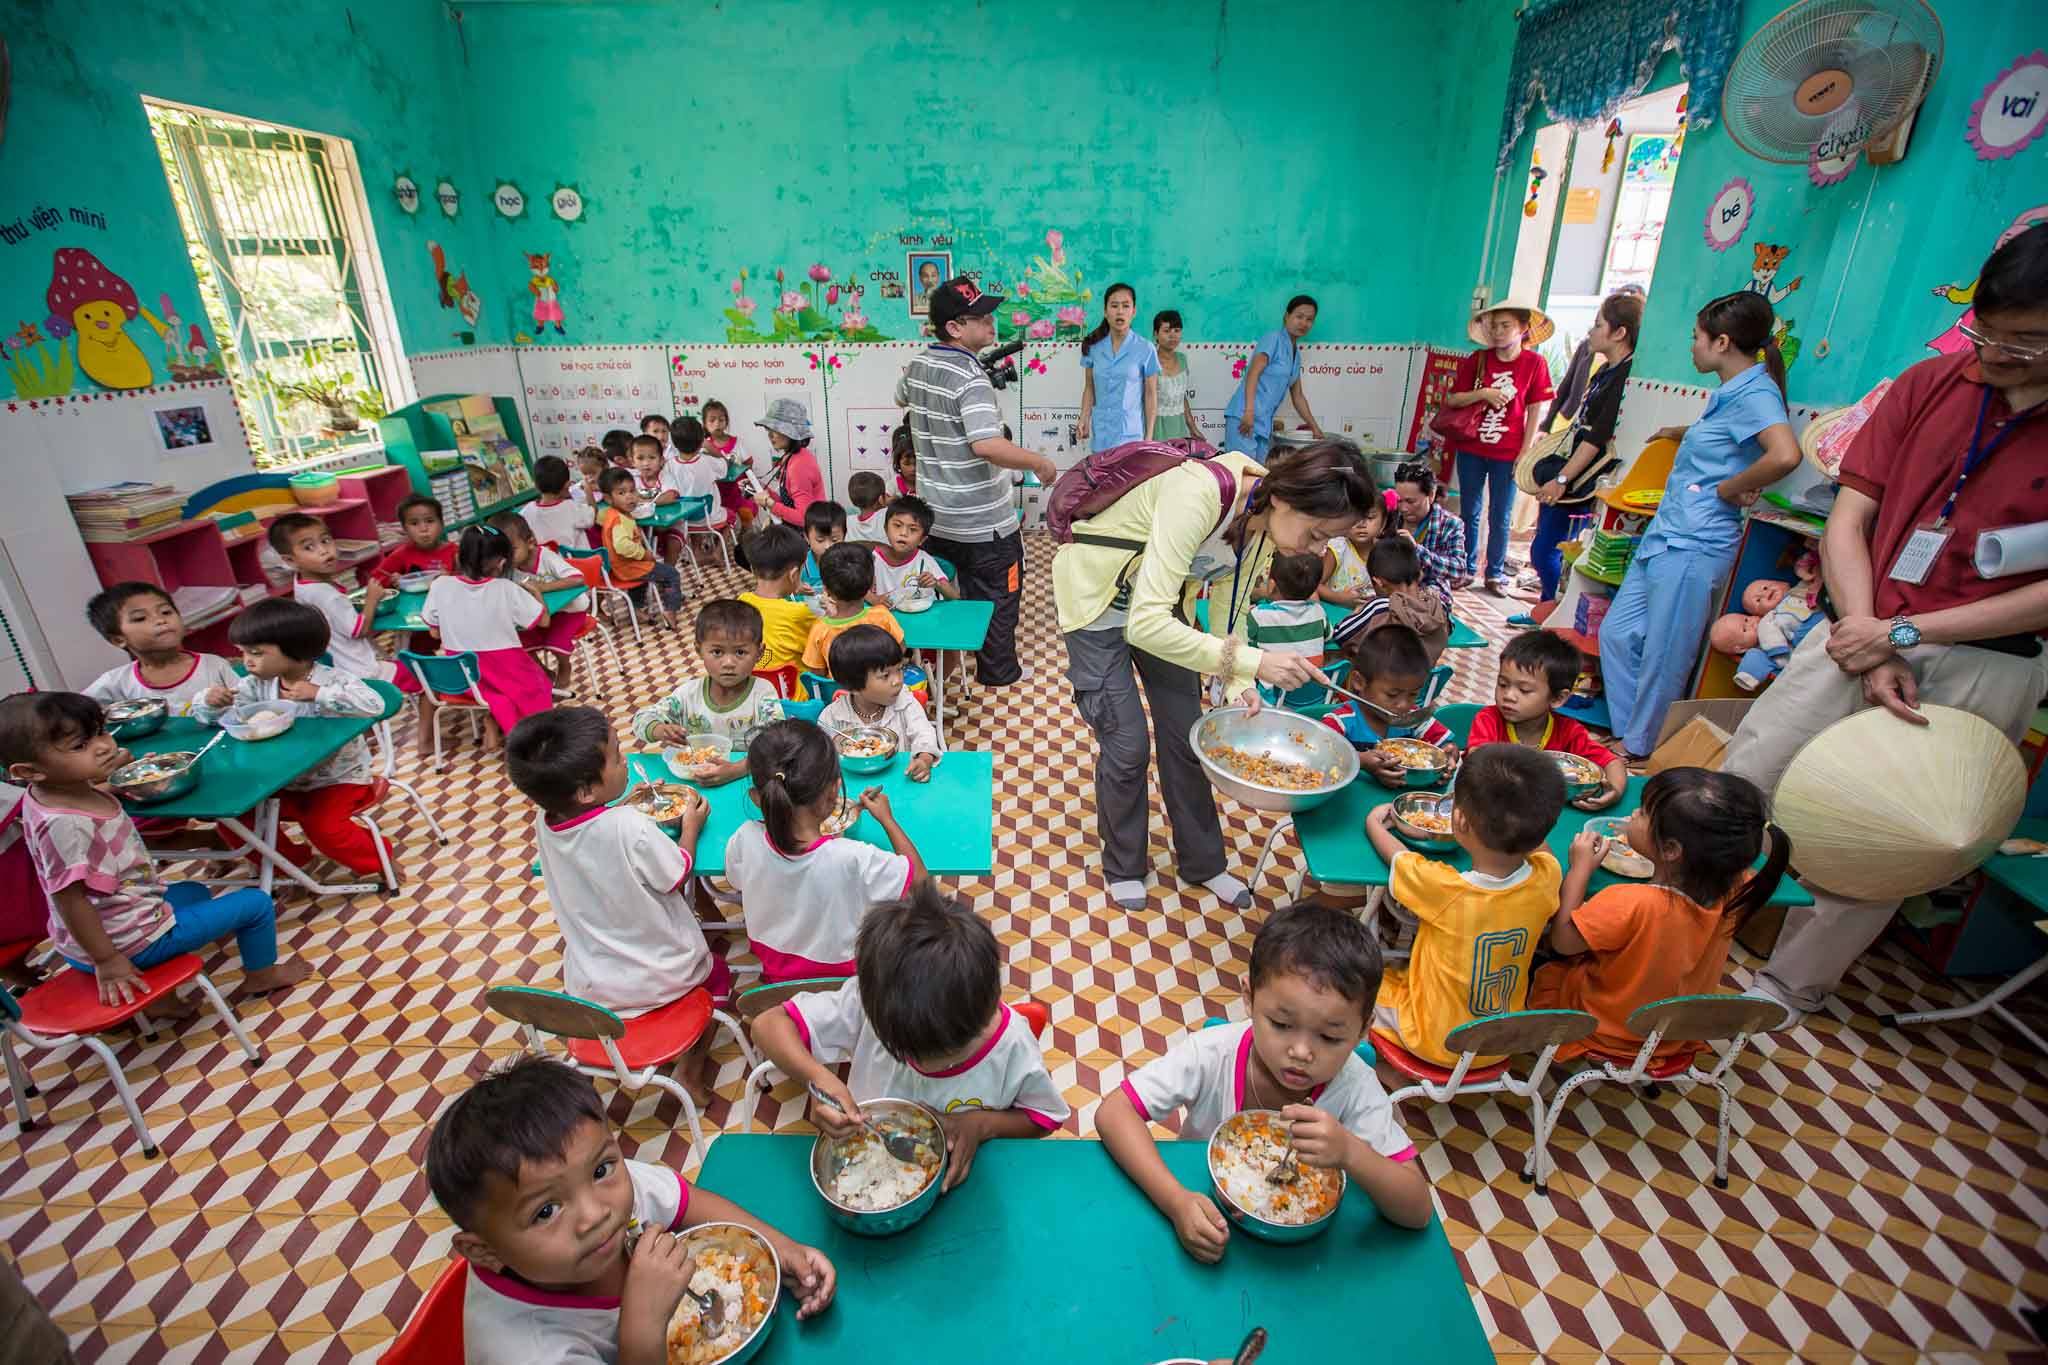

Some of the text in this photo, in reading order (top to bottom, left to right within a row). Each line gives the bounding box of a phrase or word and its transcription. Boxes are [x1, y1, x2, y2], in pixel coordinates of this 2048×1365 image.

[1722, 198, 1743, 223] bé
[2001, 91, 2040, 118] vai
[28, 205, 64, 231] viện
[69, 207, 107, 231] mini
[723, 360, 737, 368] vui
[741, 359, 759, 371] học
[1468, 927, 1529, 1017] 6
